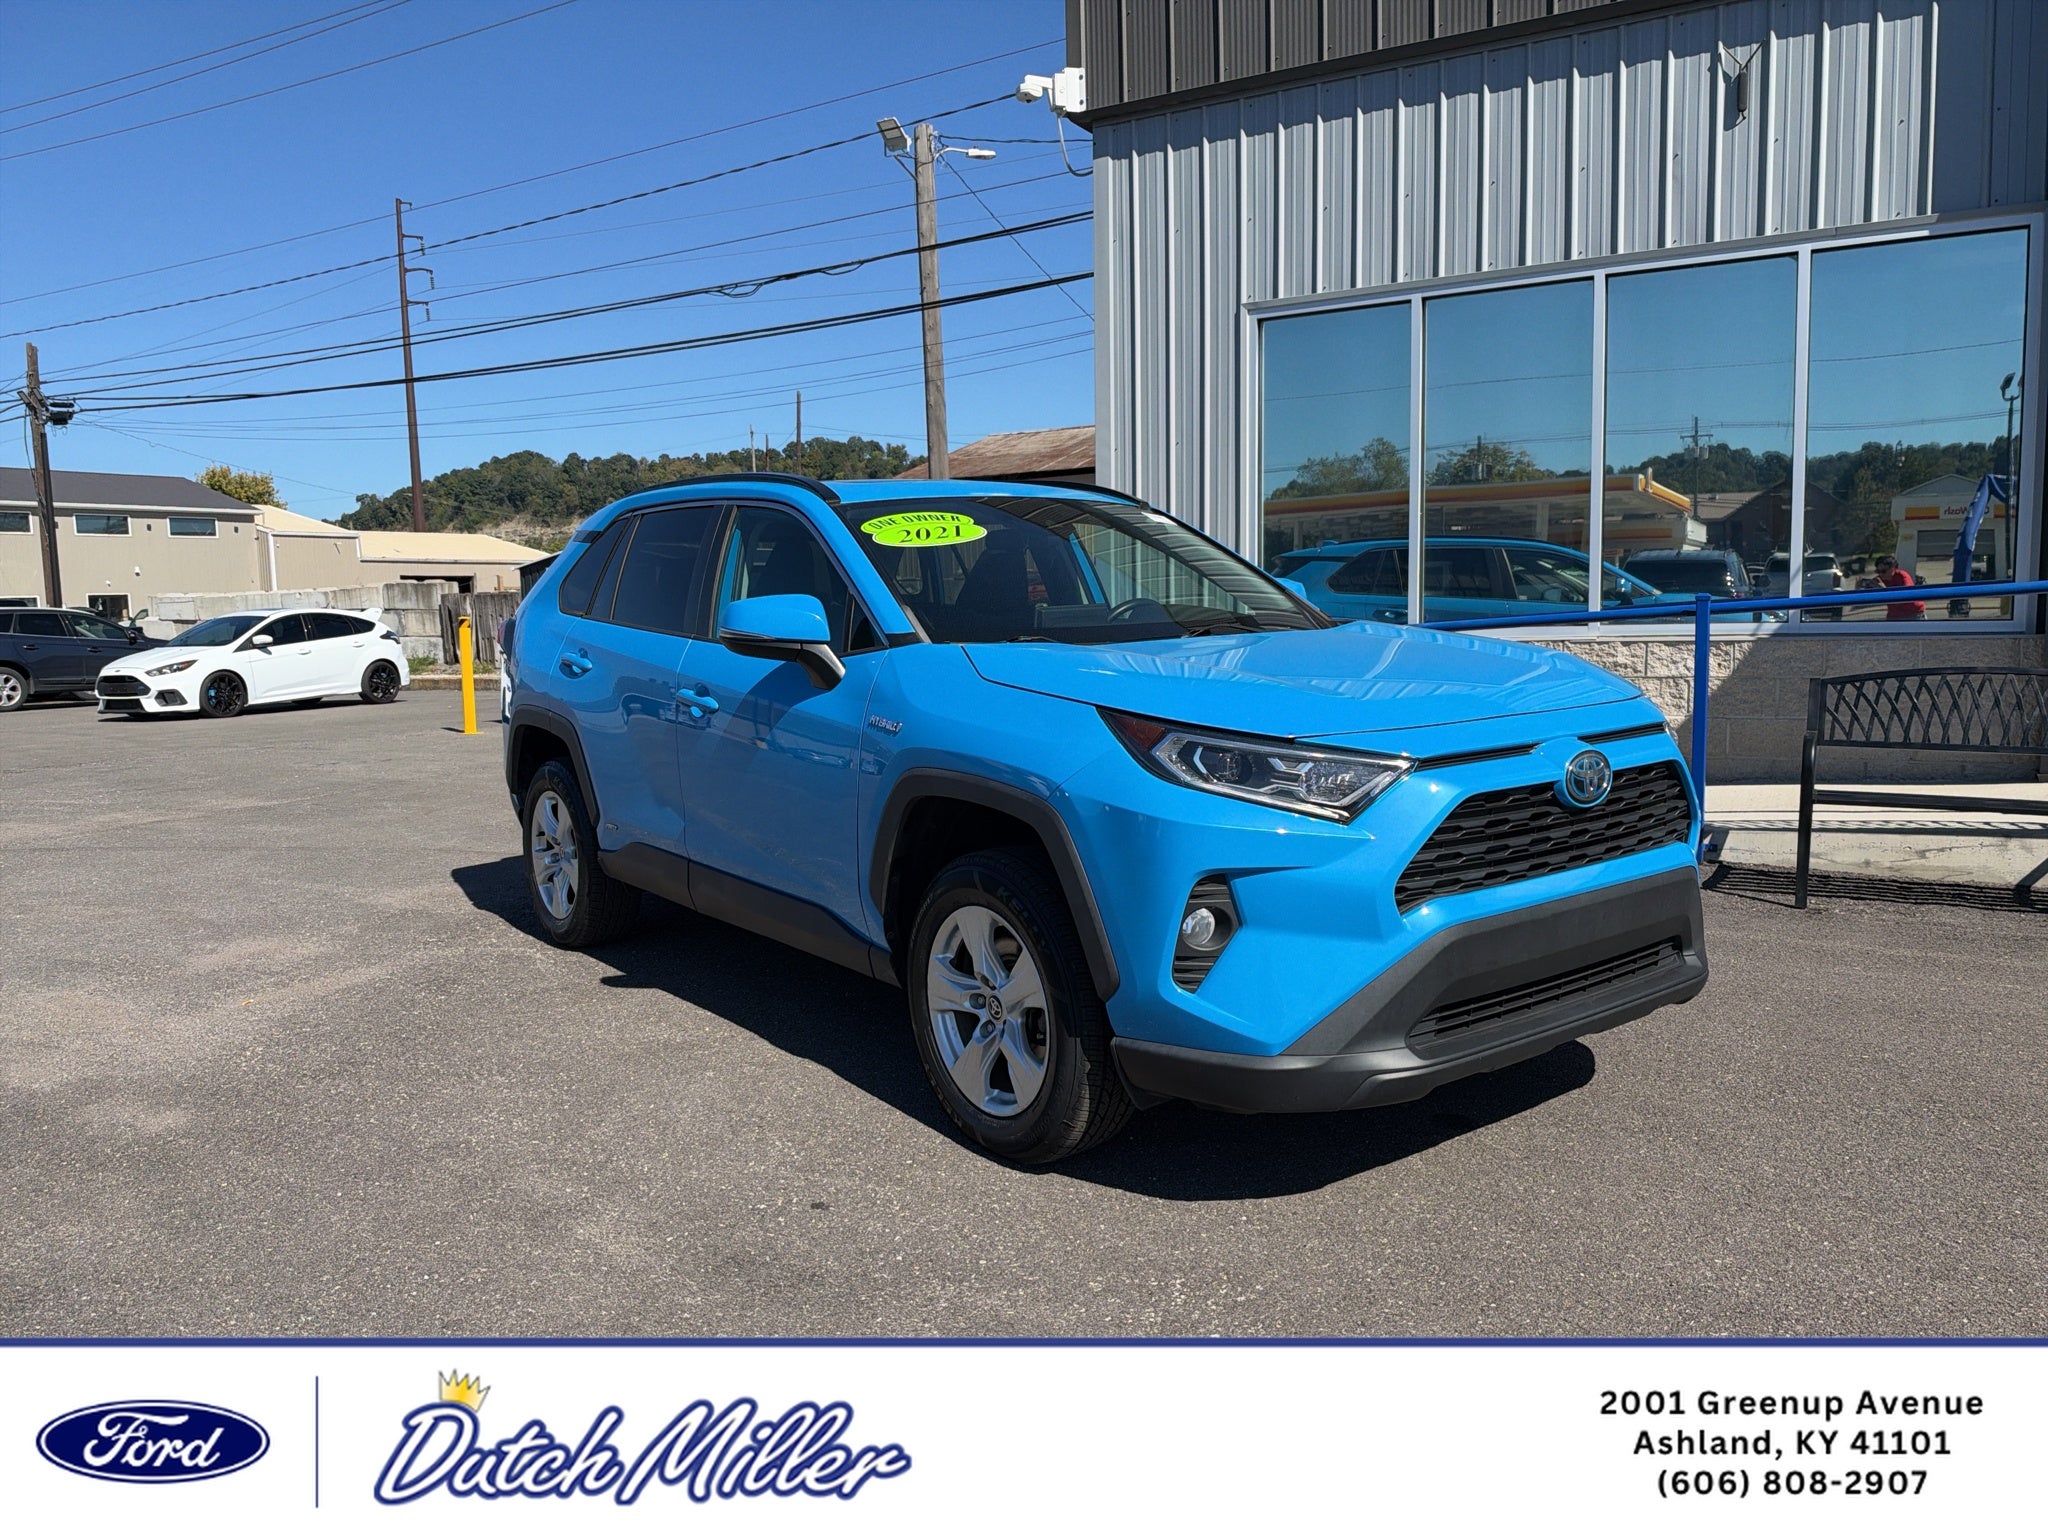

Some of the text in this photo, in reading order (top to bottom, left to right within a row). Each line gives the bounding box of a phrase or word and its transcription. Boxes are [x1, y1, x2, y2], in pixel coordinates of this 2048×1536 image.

[868, 514, 961, 529] ONE OWNER
[898, 525, 962, 543] 2021
